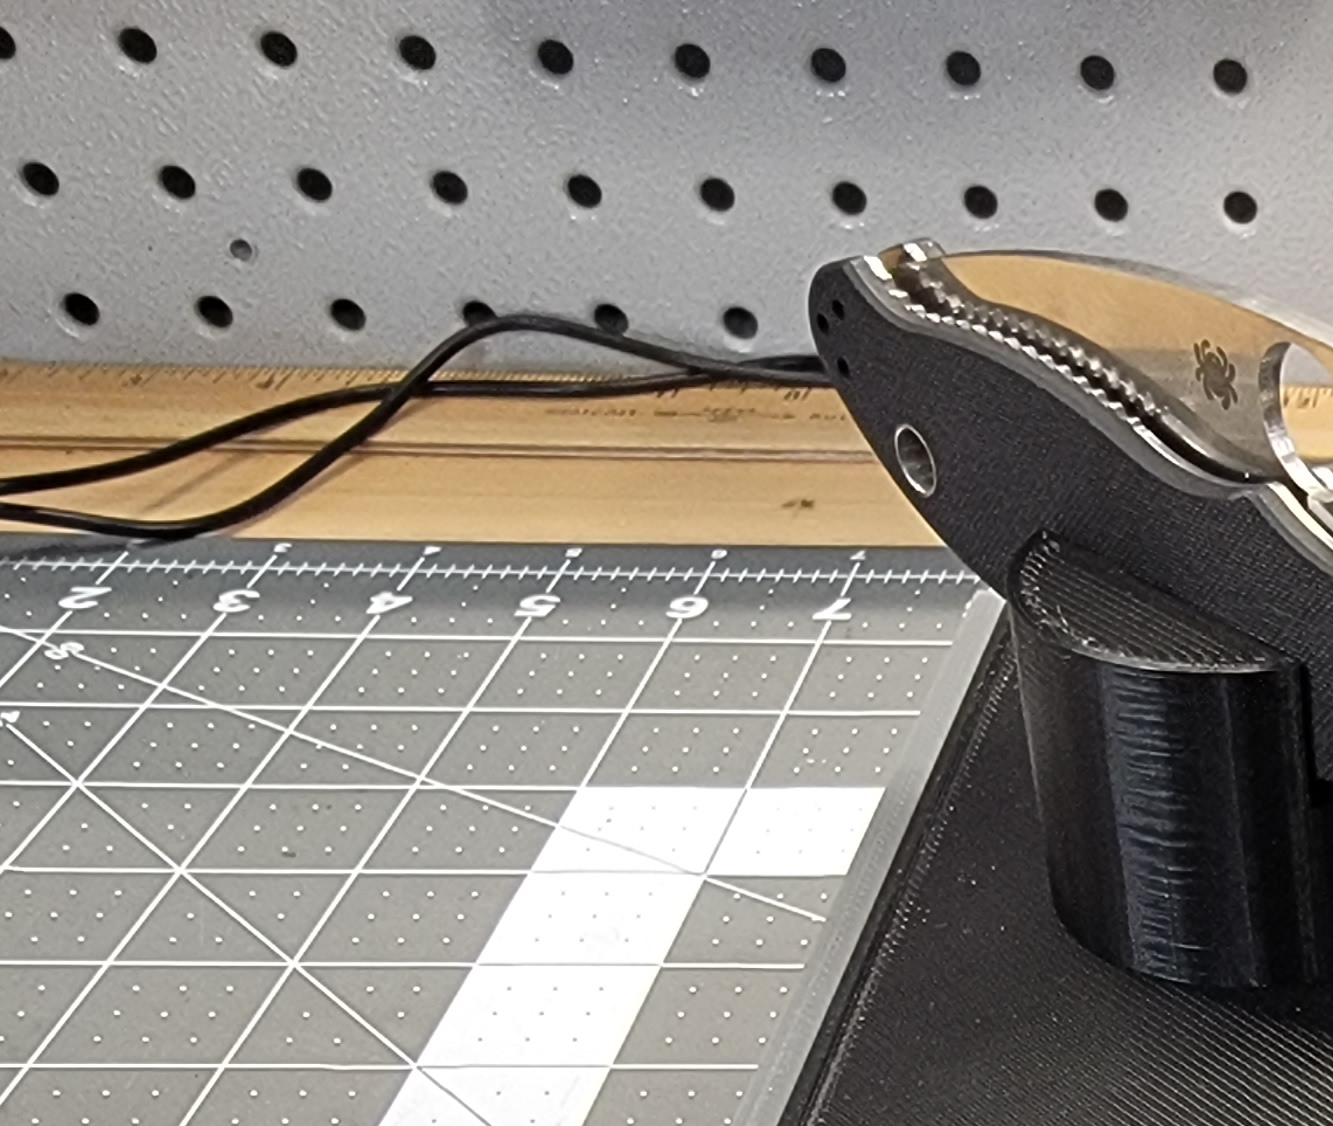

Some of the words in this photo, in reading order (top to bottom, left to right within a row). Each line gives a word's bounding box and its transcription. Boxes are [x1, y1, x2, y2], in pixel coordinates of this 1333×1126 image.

[58, 586, 112, 609] 2
[213, 590, 260, 612] 3
[366, 592, 412, 614] 4
[514, 594, 560, 617] 5
[666, 596, 708, 618] 6
[812, 597, 851, 620] 7
